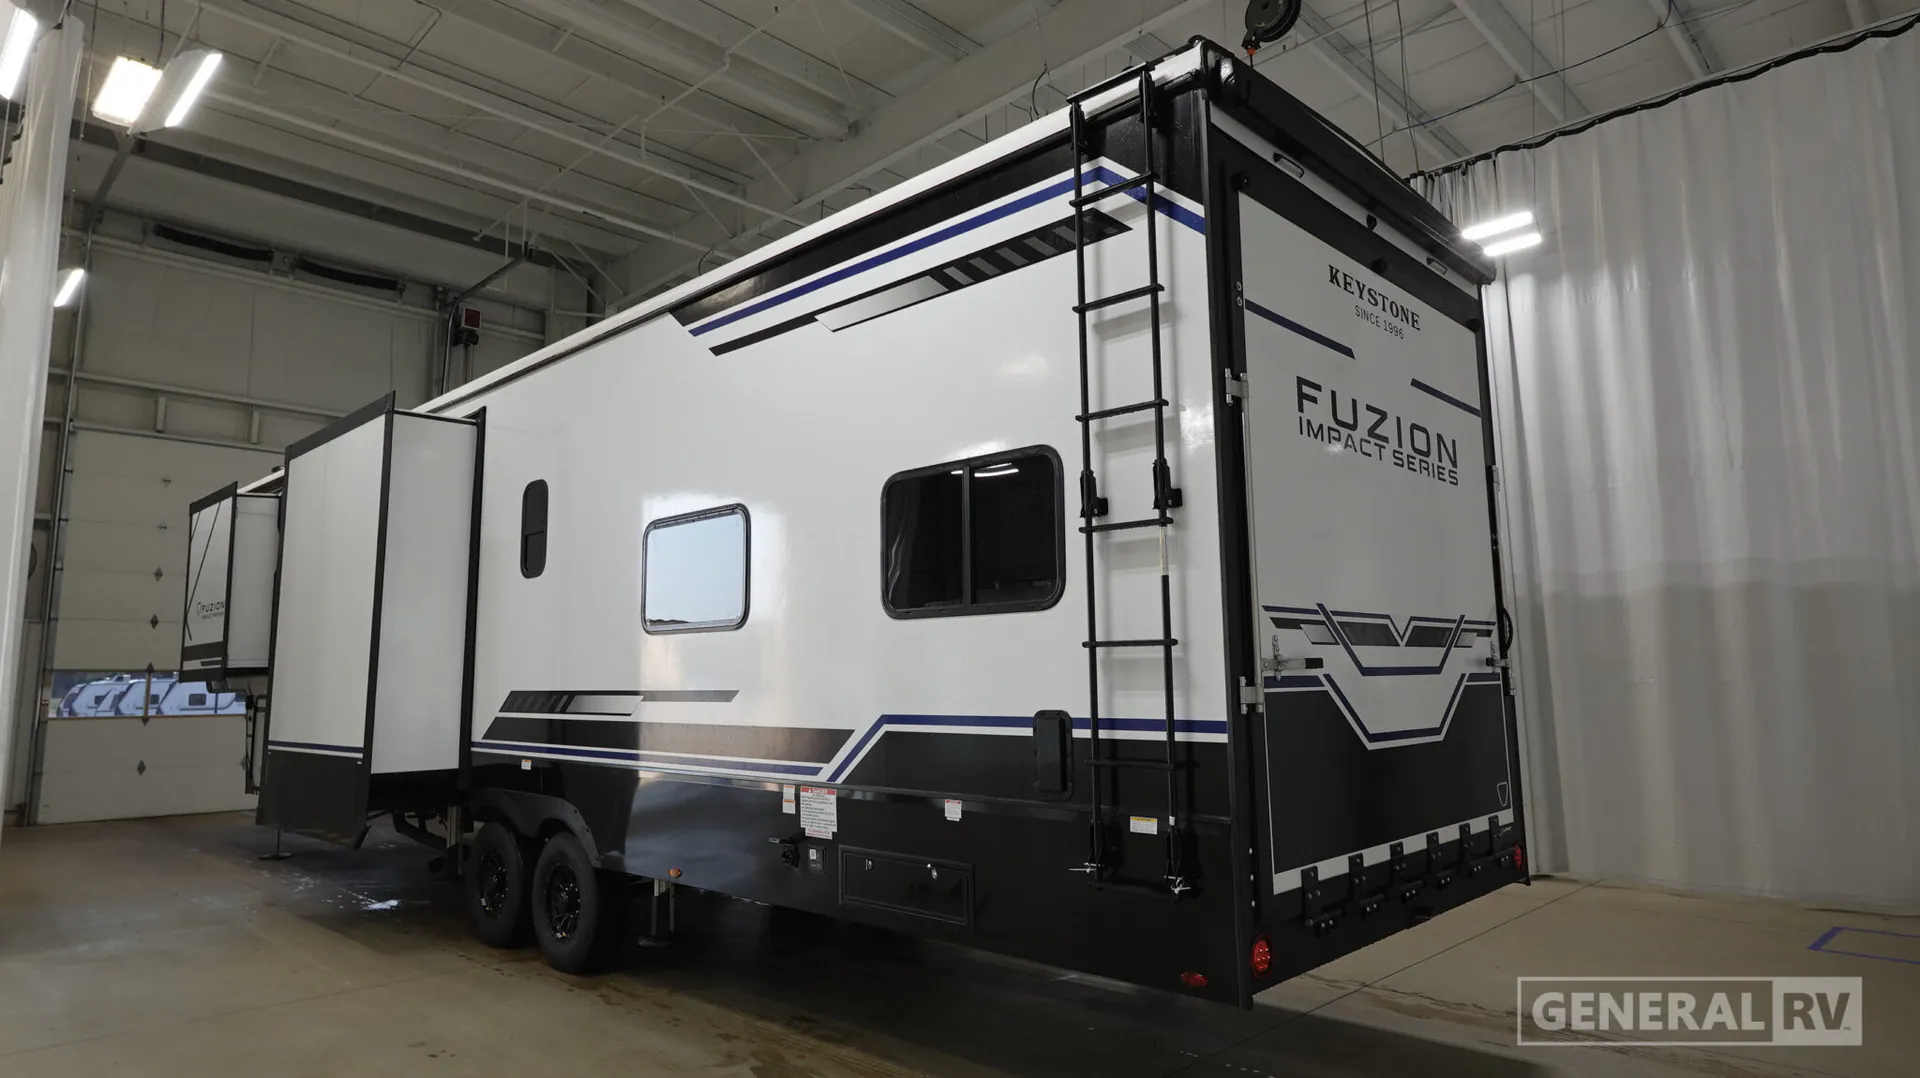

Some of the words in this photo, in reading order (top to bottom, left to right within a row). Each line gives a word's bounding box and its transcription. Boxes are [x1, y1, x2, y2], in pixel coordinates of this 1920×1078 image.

[1328, 264, 1421, 331] KEYSTONE
[1355, 304, 1381, 328] SINCE
[1383, 319, 1404, 340] 1996
[1296, 375, 1458, 469] FUZION
[1299, 416, 1386, 461] IMPACT
[1392, 449, 1459, 486] SERIES
